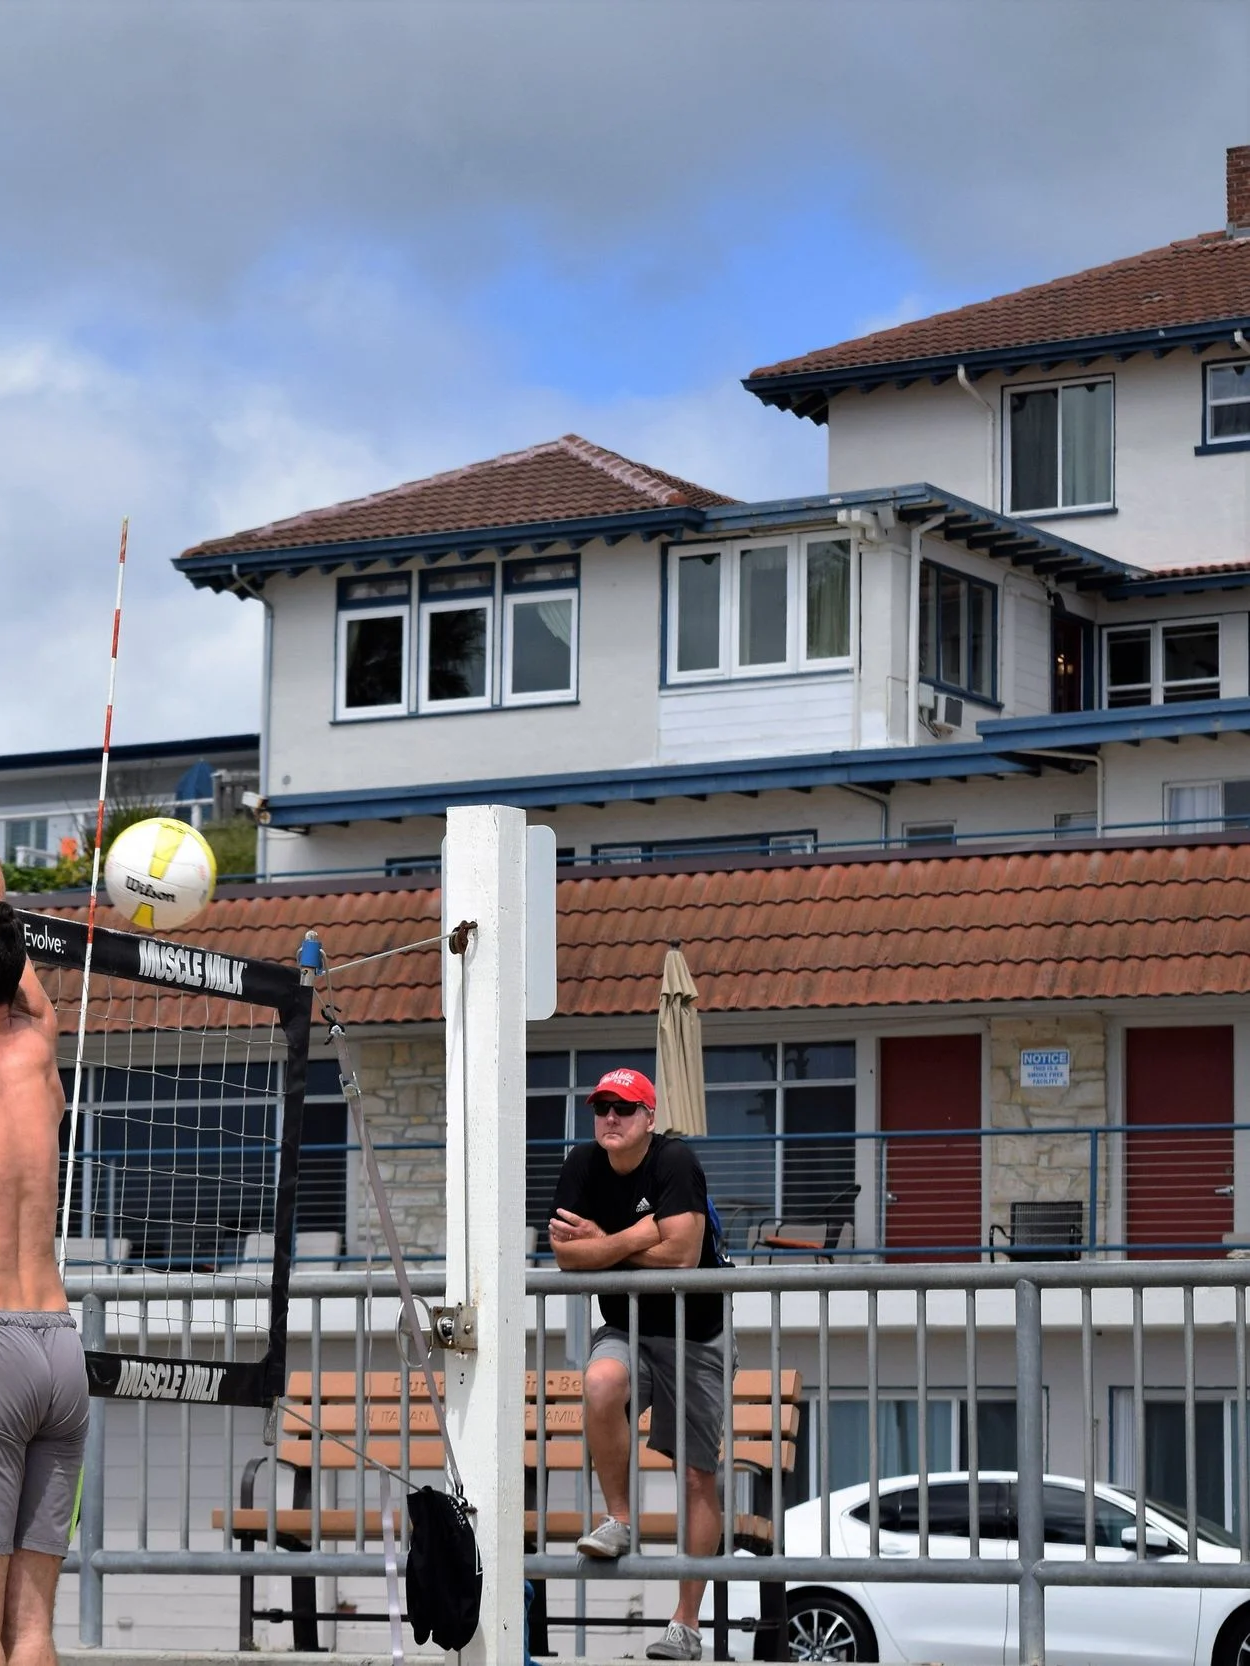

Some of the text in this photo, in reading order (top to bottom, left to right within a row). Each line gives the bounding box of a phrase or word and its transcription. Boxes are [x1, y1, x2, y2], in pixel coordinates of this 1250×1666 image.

[125, 875, 177, 903] Wilson
[138, 940, 243, 995] MUSCLE MILK
[1024, 1053, 1067, 1064] NOTICE
[114, 1359, 224, 1402] MUSCLE MILK
